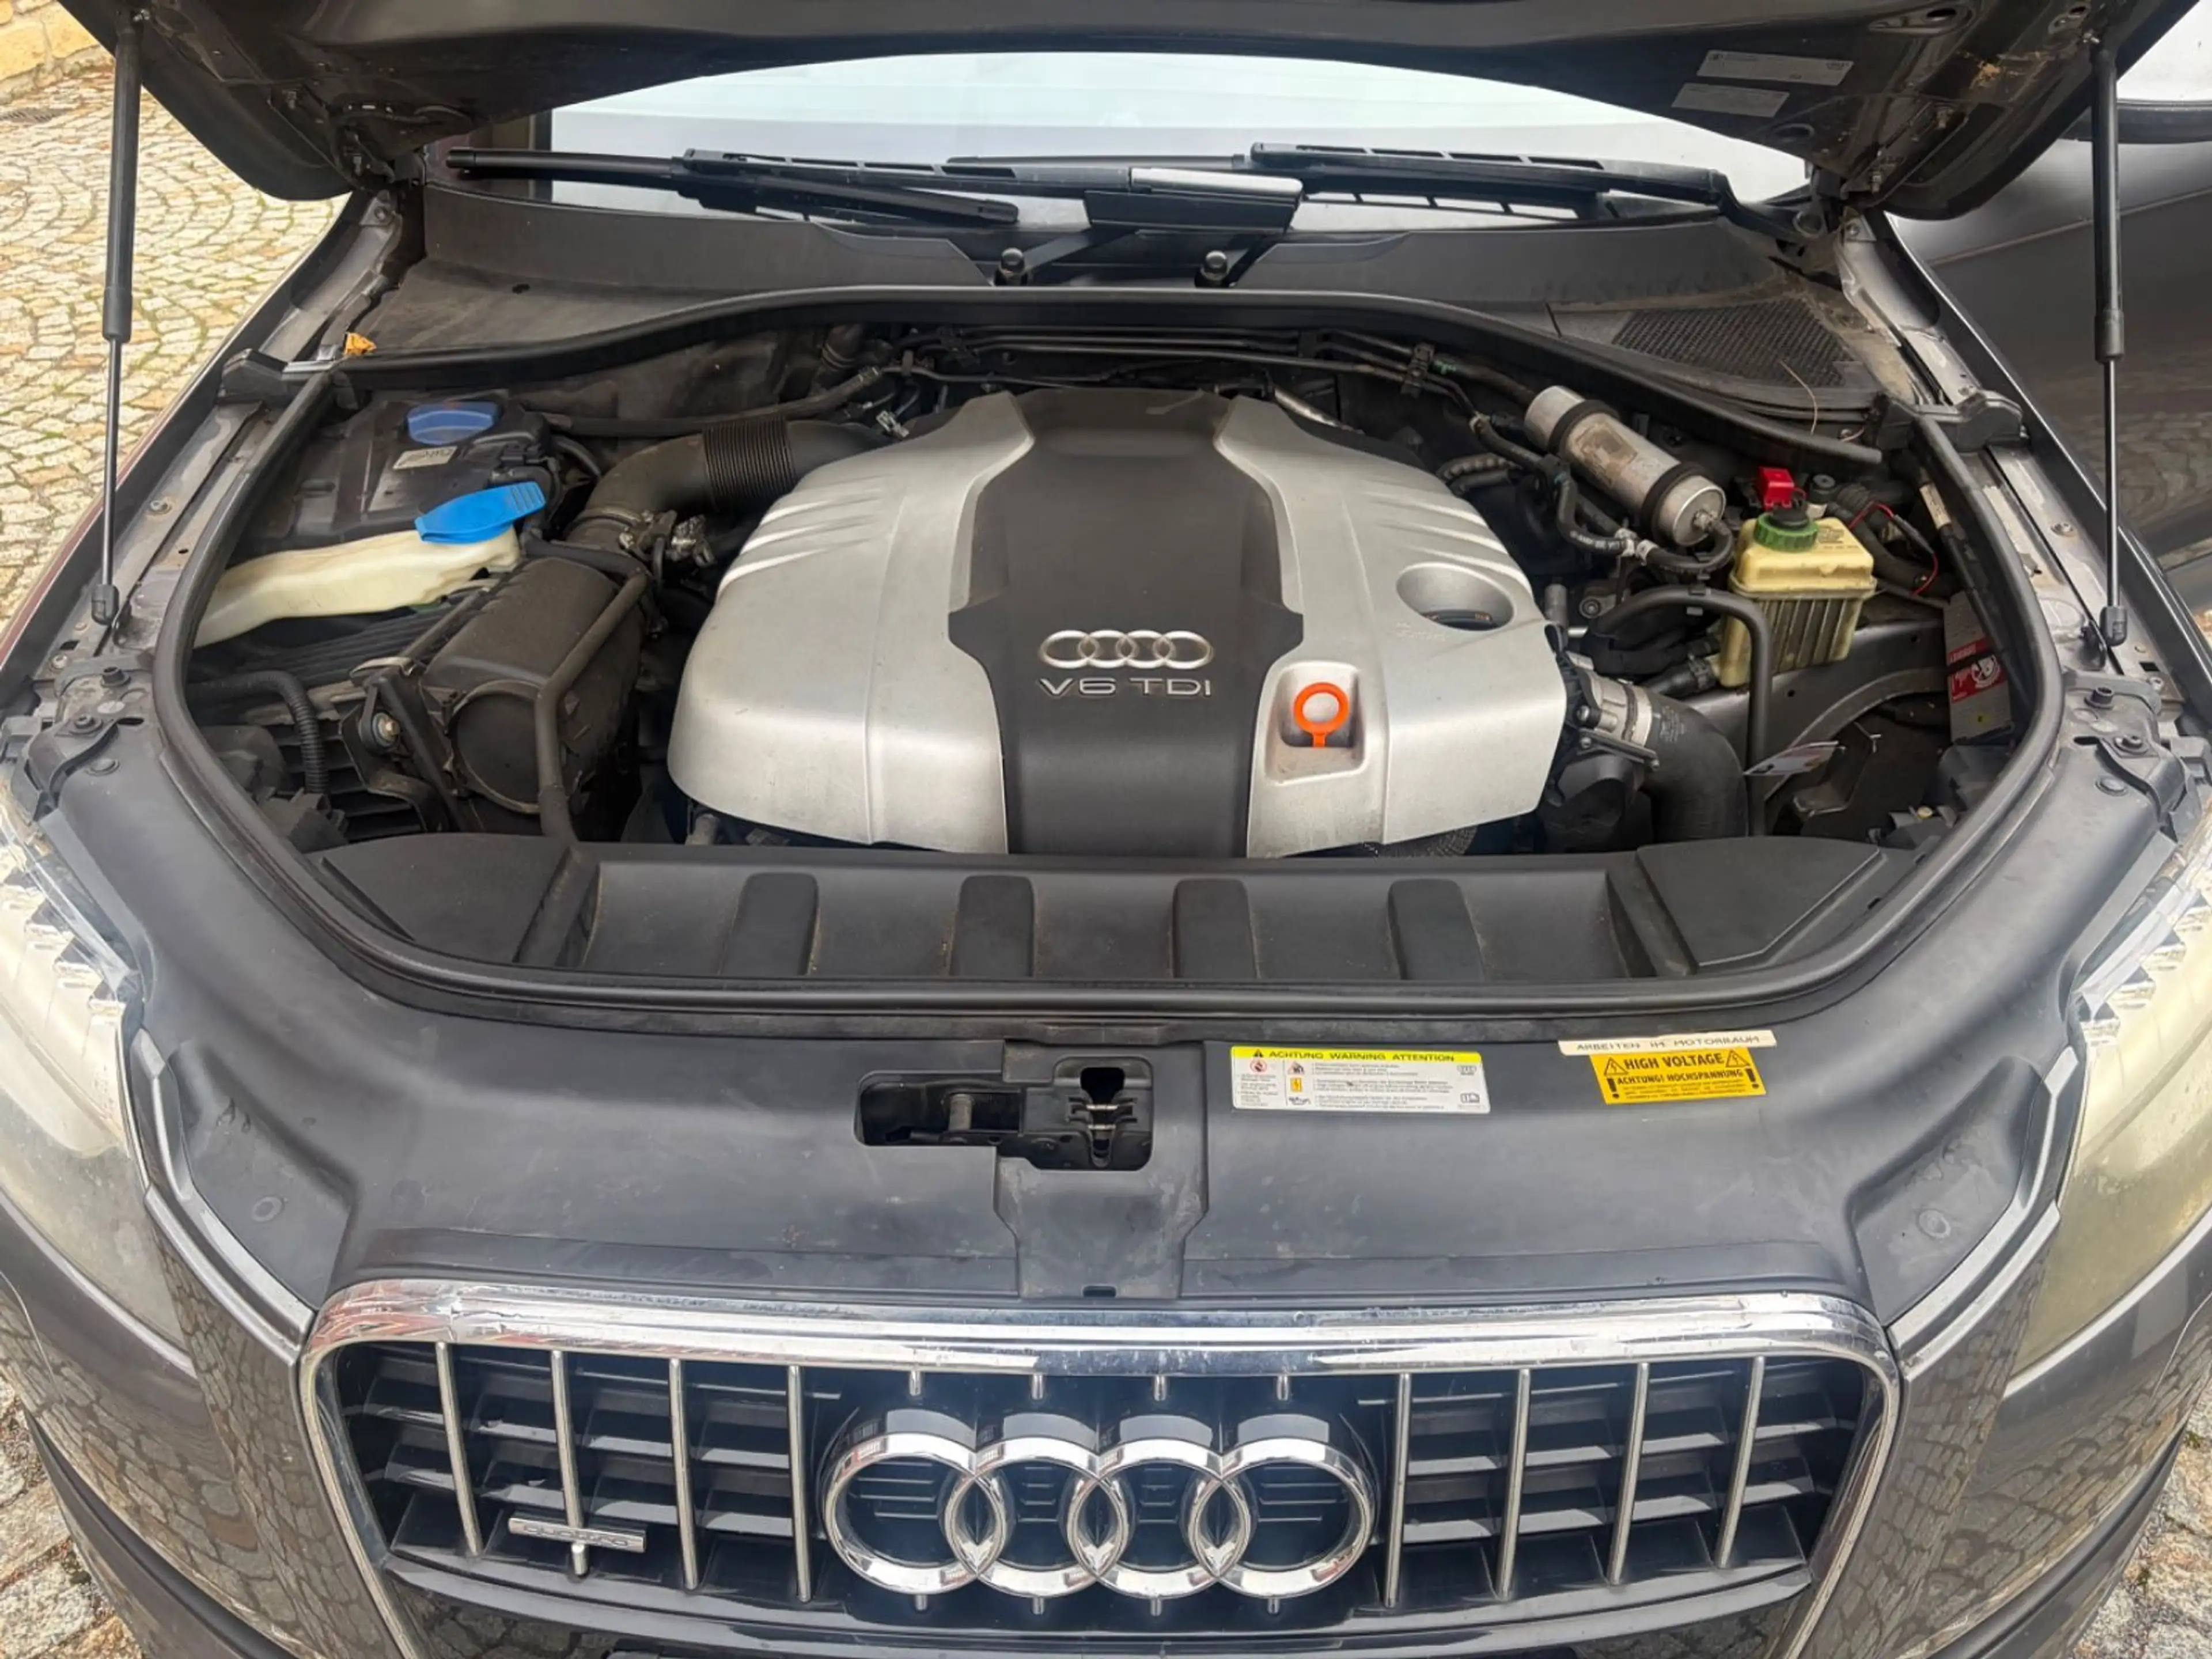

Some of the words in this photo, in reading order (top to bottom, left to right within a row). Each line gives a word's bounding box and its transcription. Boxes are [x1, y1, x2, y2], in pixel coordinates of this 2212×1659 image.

[1040, 677, 1116, 696] V6
[1130, 677, 1211, 696] TDI
[1269, 1051, 1324, 1059] ACHTUNG
[1329, 1052, 1386, 1060] WARNING
[1392, 1054, 1455, 1062] ATTENTION
[1624, 1057, 1660, 1070] HIGH
[1662, 1053, 1725, 1068] VOLTAGE
[1617, 1074, 1664, 1085] ACHTUNG!
[1666, 1069, 1744, 1082] HOCHSPANNUNG
